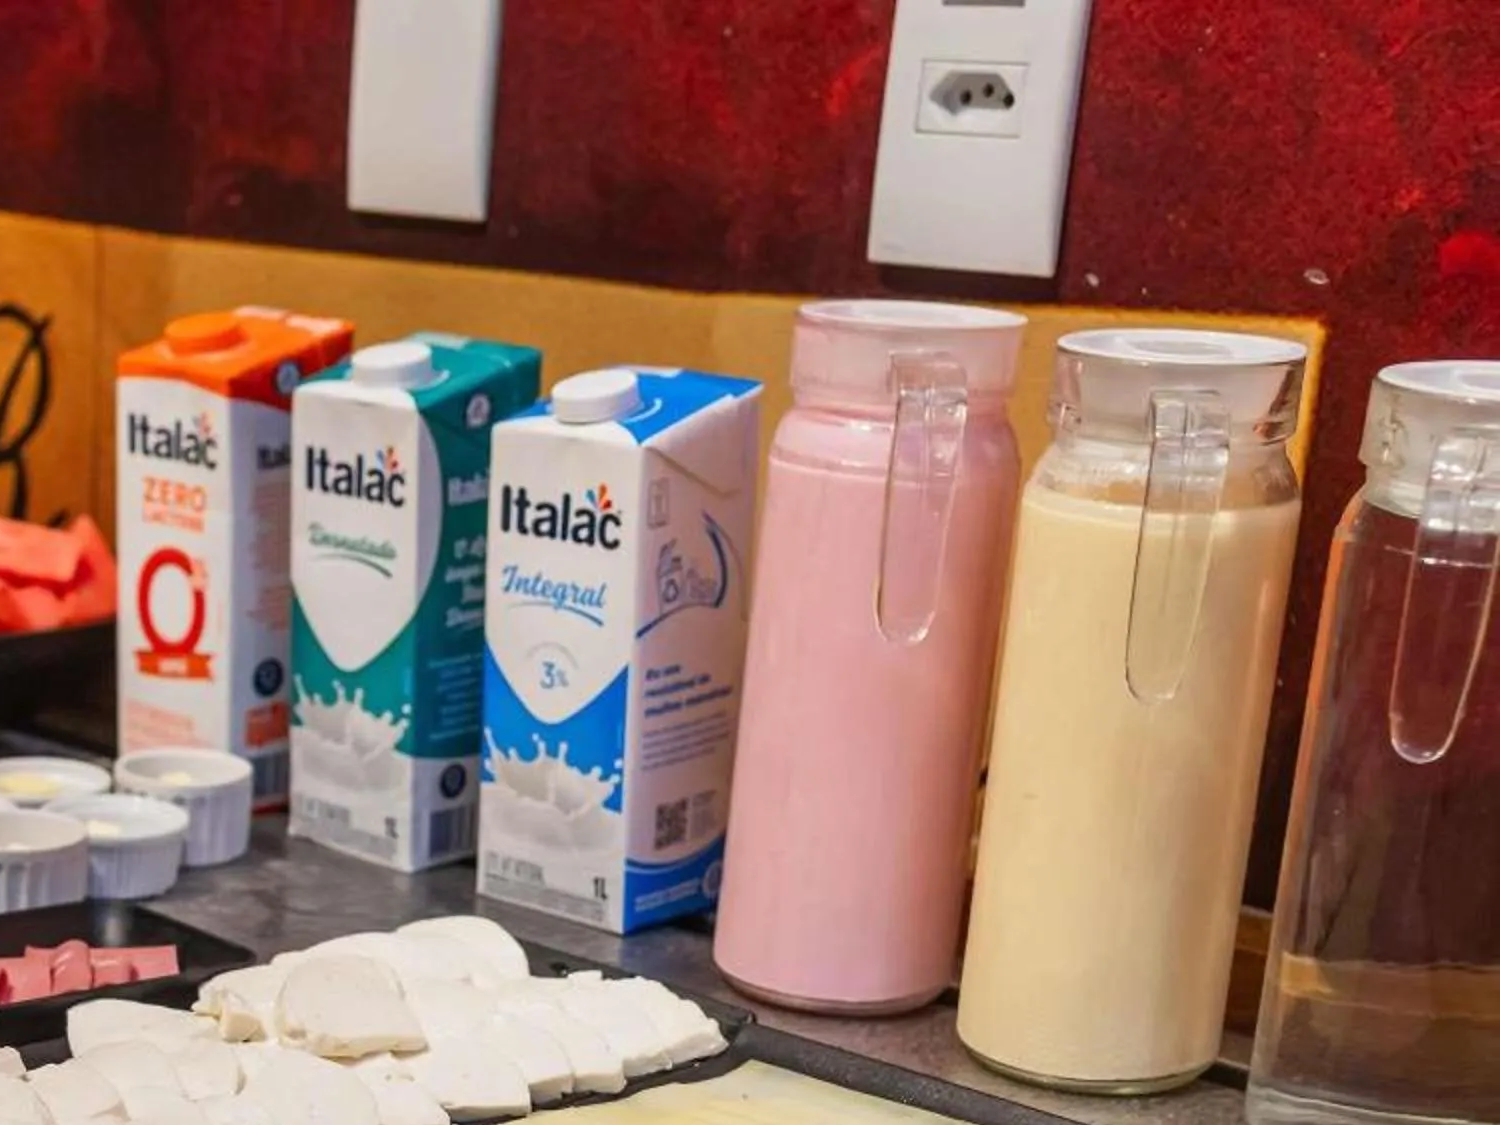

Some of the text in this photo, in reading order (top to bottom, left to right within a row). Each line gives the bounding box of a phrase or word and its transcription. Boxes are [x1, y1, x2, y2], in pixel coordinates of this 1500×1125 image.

[128, 412, 218, 471] Italac
[143, 475, 207, 512] ZERO
[305, 446, 406, 508] Italac
[500, 484, 622, 549] Italac
[502, 564, 607, 609] Integral
